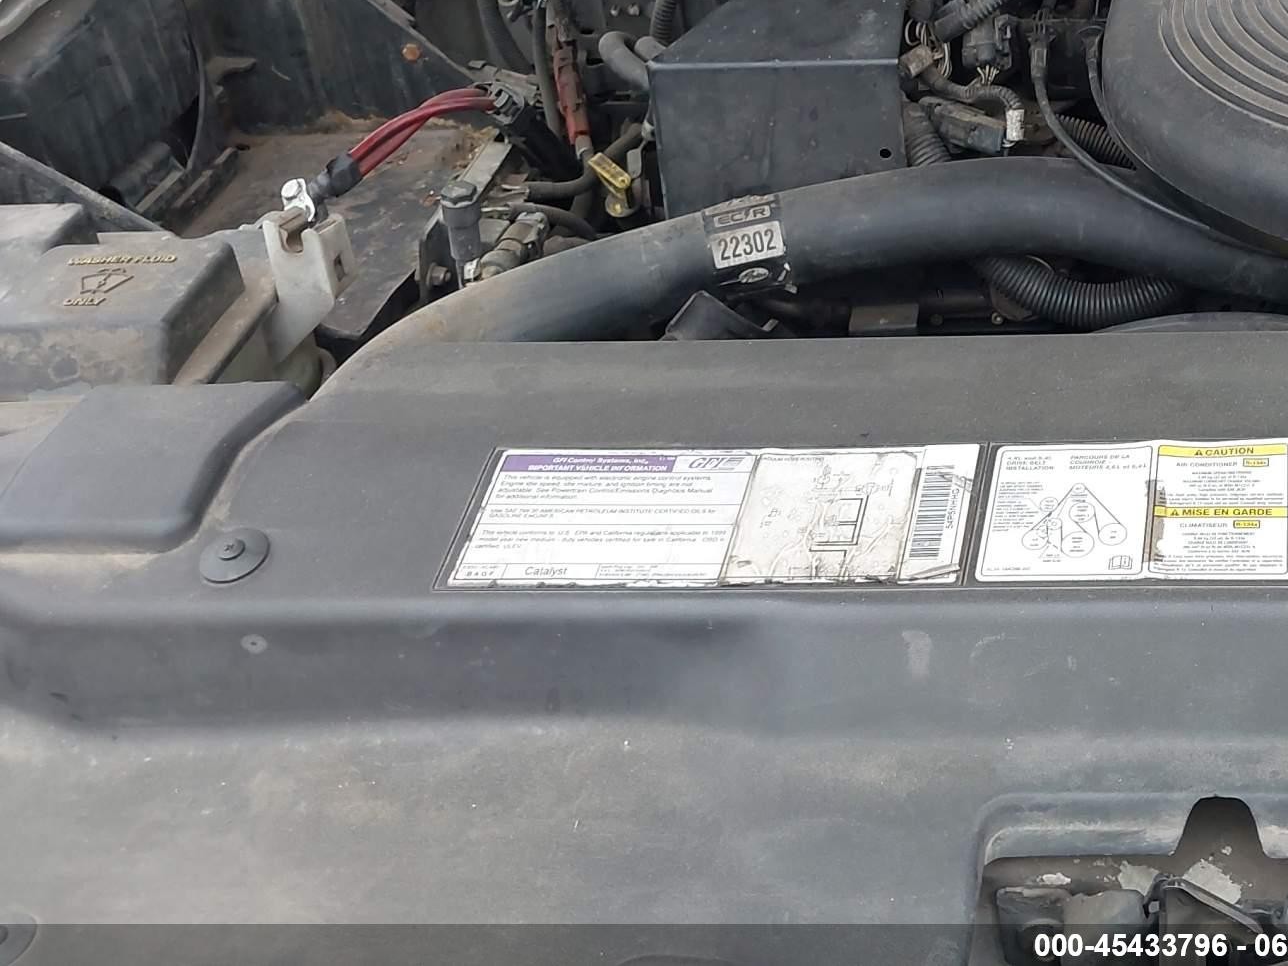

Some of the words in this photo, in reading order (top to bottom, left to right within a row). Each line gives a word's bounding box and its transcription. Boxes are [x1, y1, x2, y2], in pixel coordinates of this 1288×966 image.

[718, 229, 777, 261] 22302
[63, 297, 106, 306] ONLY
[1205, 447, 1254, 456] CAUTION
[1182, 508, 1210, 516] MISE
[1213, 508, 1230, 516] EN
[1232, 508, 1273, 516] GARDE
[524, 566, 569, 577] Catalyst
